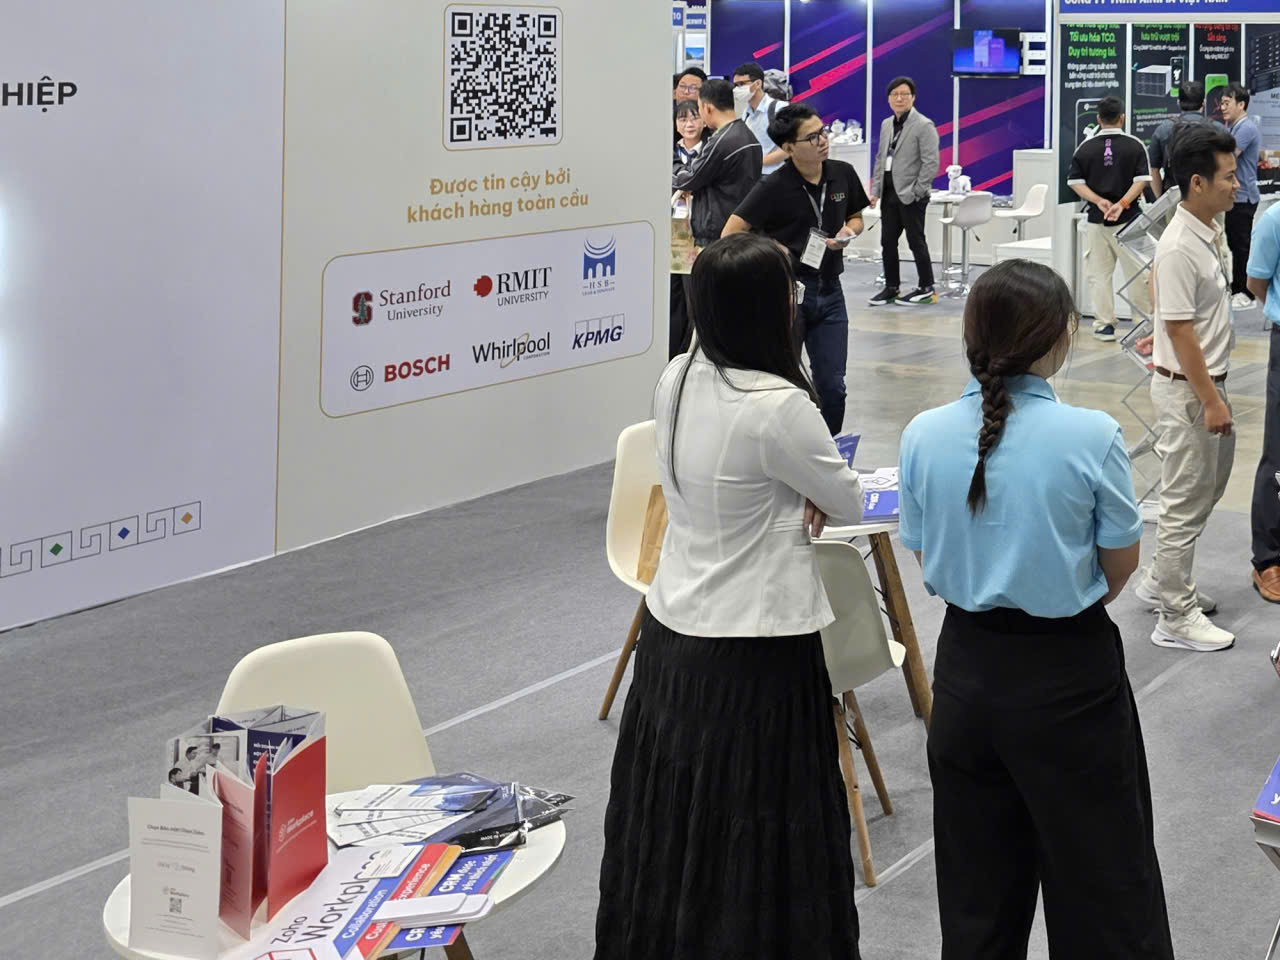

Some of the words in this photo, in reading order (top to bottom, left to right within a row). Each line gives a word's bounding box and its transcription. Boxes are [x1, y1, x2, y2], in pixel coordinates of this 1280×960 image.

[429, 178, 478, 197] Được
[483, 172, 505, 189] tin
[510, 171, 540, 191] cậy
[545, 168, 570, 185] bởi
[407, 201, 465, 223] khách
[469, 198, 513, 217] hàng
[517, 194, 555, 211] toàn
[560, 190, 589, 207] cầu
[379, 280, 451, 307] Stanford
[496, 267, 552, 295] RMIT
[387, 304, 443, 321] University
[497, 290, 549, 307] UNIVERSITY
[472, 331, 550, 363] Whirlpool
[571, 325, 623, 350] KPMG
[384, 353, 450, 383] BOSCH
[341, 889, 388, 939] Collaboration
[270, 916, 308, 945] Zoho
